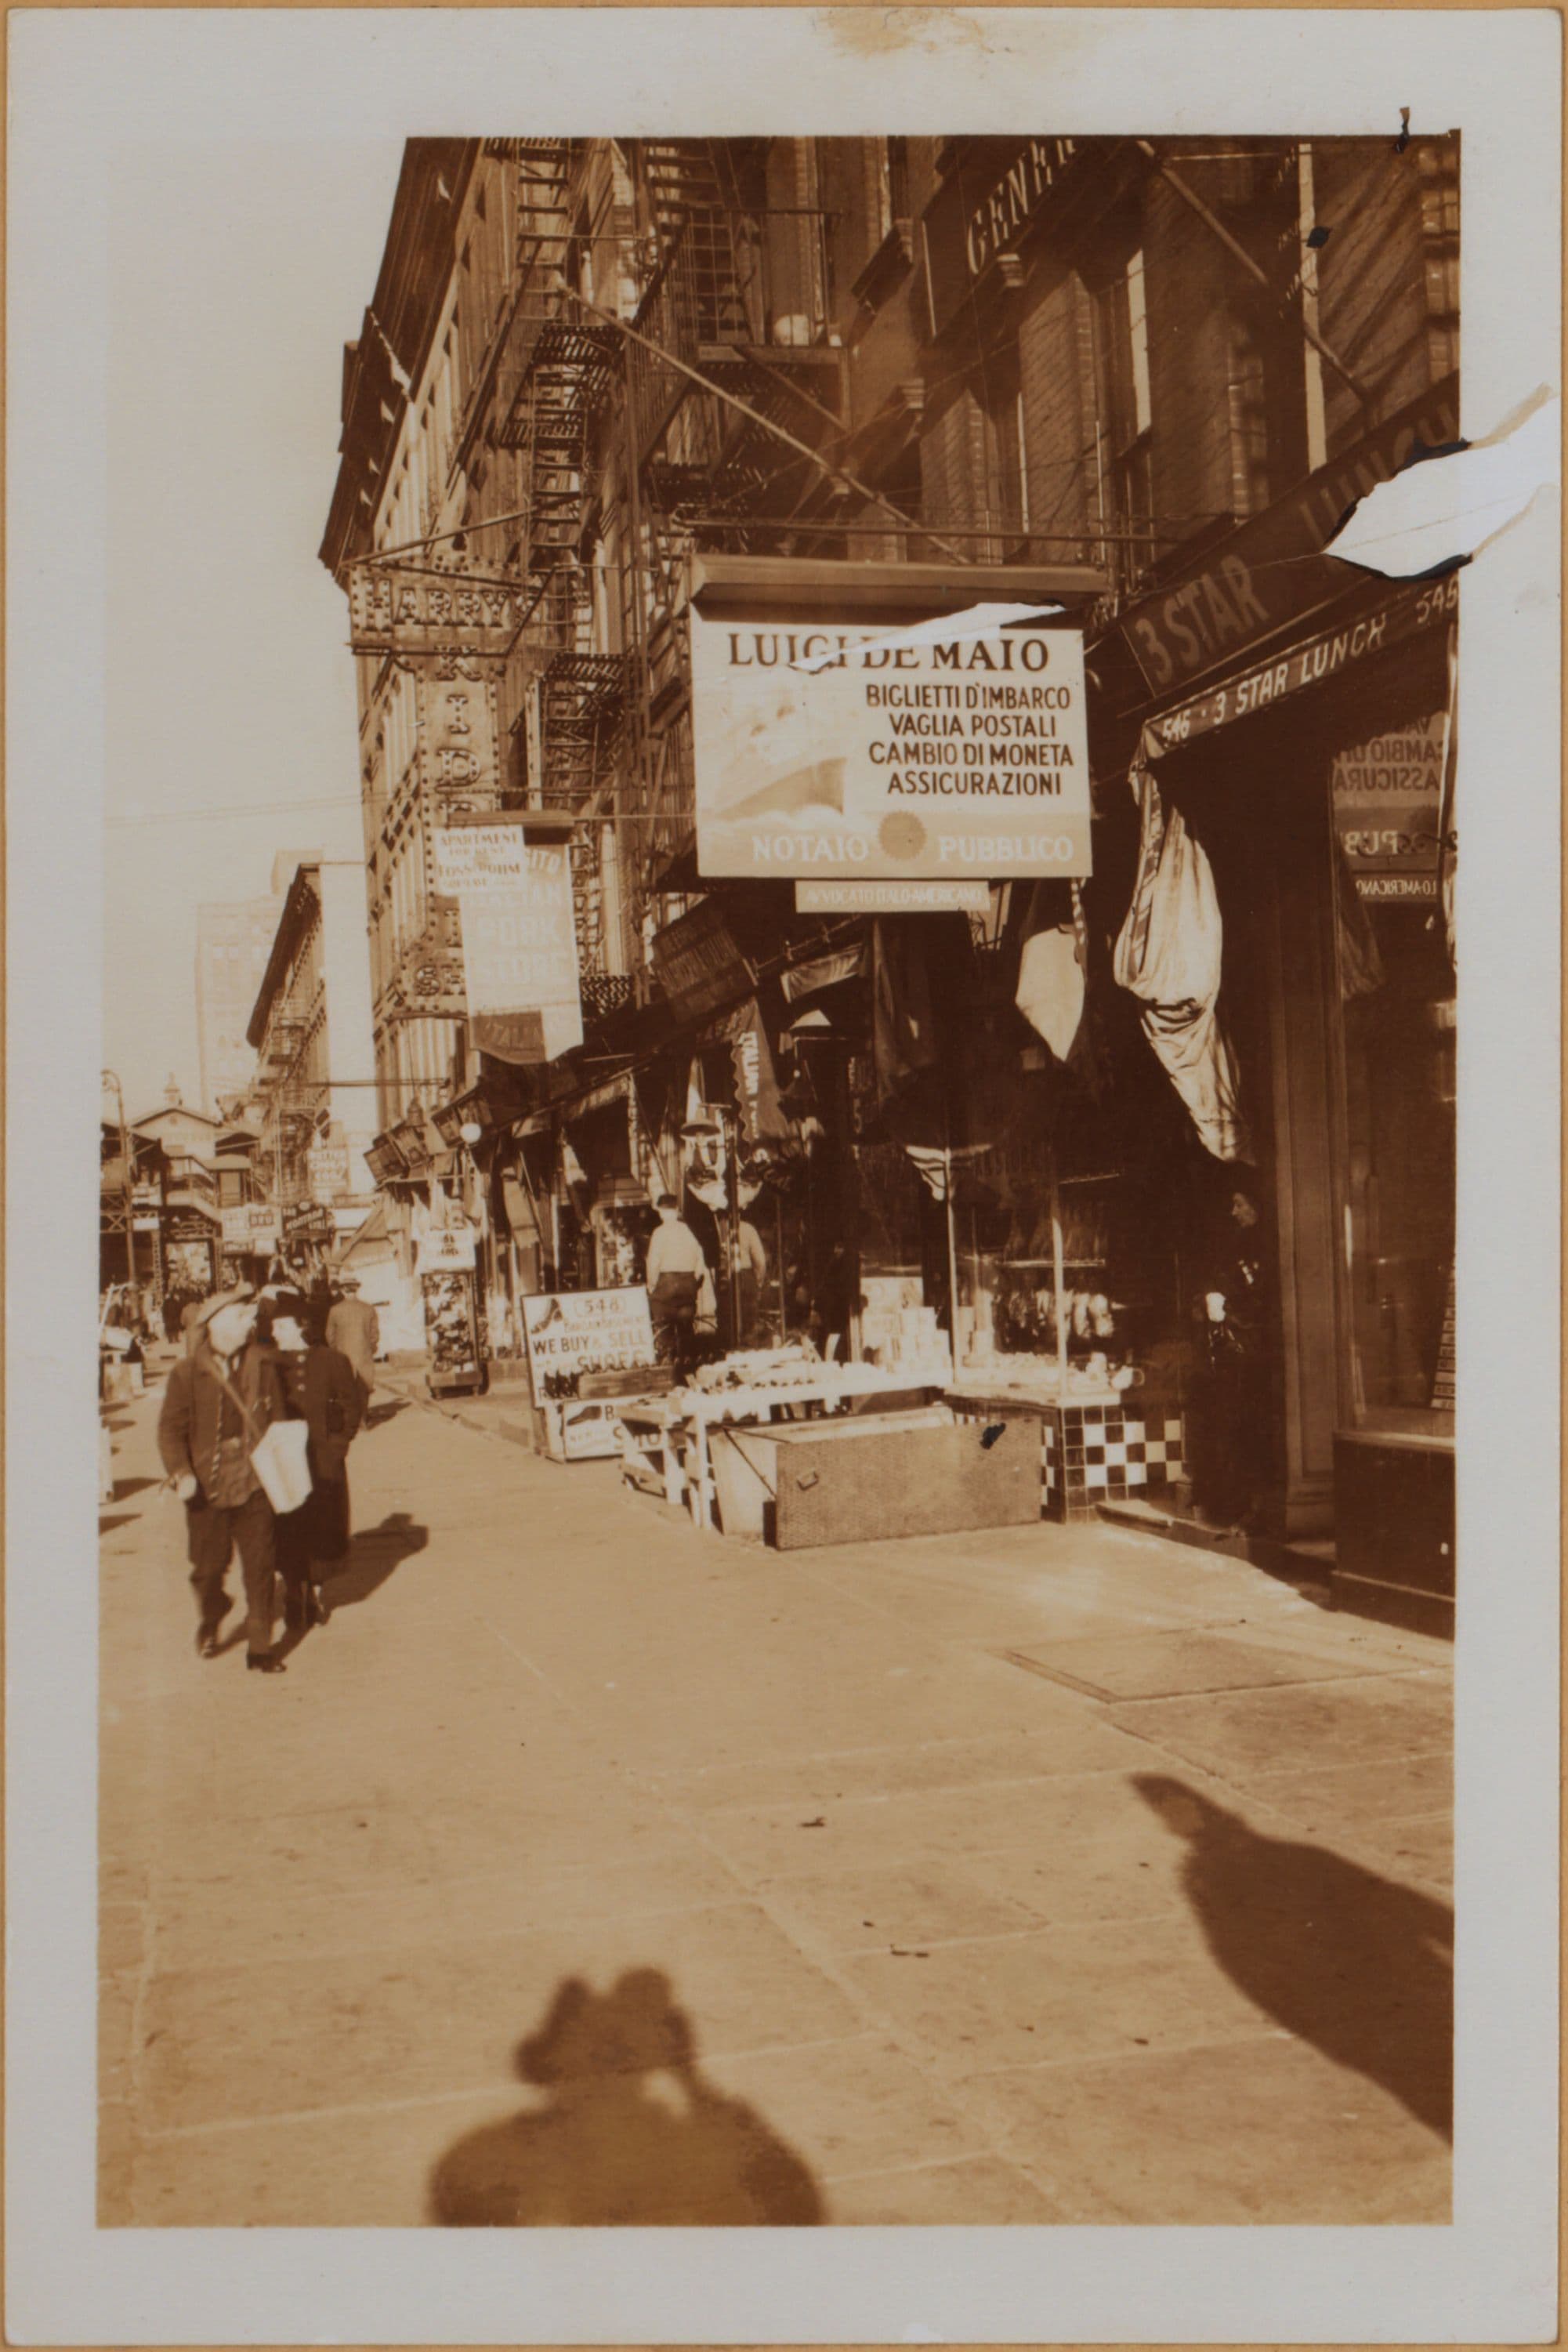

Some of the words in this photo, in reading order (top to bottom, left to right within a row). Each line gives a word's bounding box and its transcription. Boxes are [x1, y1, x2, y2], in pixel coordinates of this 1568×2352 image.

[1136, 618, 1172, 684] 3
[1163, 554, 1270, 668] STAR
[728, 633, 848, 668] LUIGI
[862, 636, 920, 669] DE
[931, 639, 1049, 672] MAIO
[1163, 708, 1190, 742] 546
[1215, 691, 1228, 725] 3
[1236, 664, 1289, 714] STAR
[1300, 613, 1387, 683] LUNCH
[866, 683, 960, 708] BIGLIETTI
[889, 713, 964, 737] VAGLIA
[972, 715, 1056, 737] POSTALI
[869, 741, 958, 766] CAMBIO
[964, 743, 983, 766] DI
[990, 744, 1074, 767] MONETA
[887, 771, 1062, 795] ASSICURAZIONI
[440, 832, 517, 846] APARTMENT
[751, 835, 869, 861] NOTAIO
[940, 835, 1074, 861] PUBBLICO
[533, 1337, 556, 1355] WE
[561, 1335, 589, 1352] BUY
[610, 1330, 648, 1349] SELL
